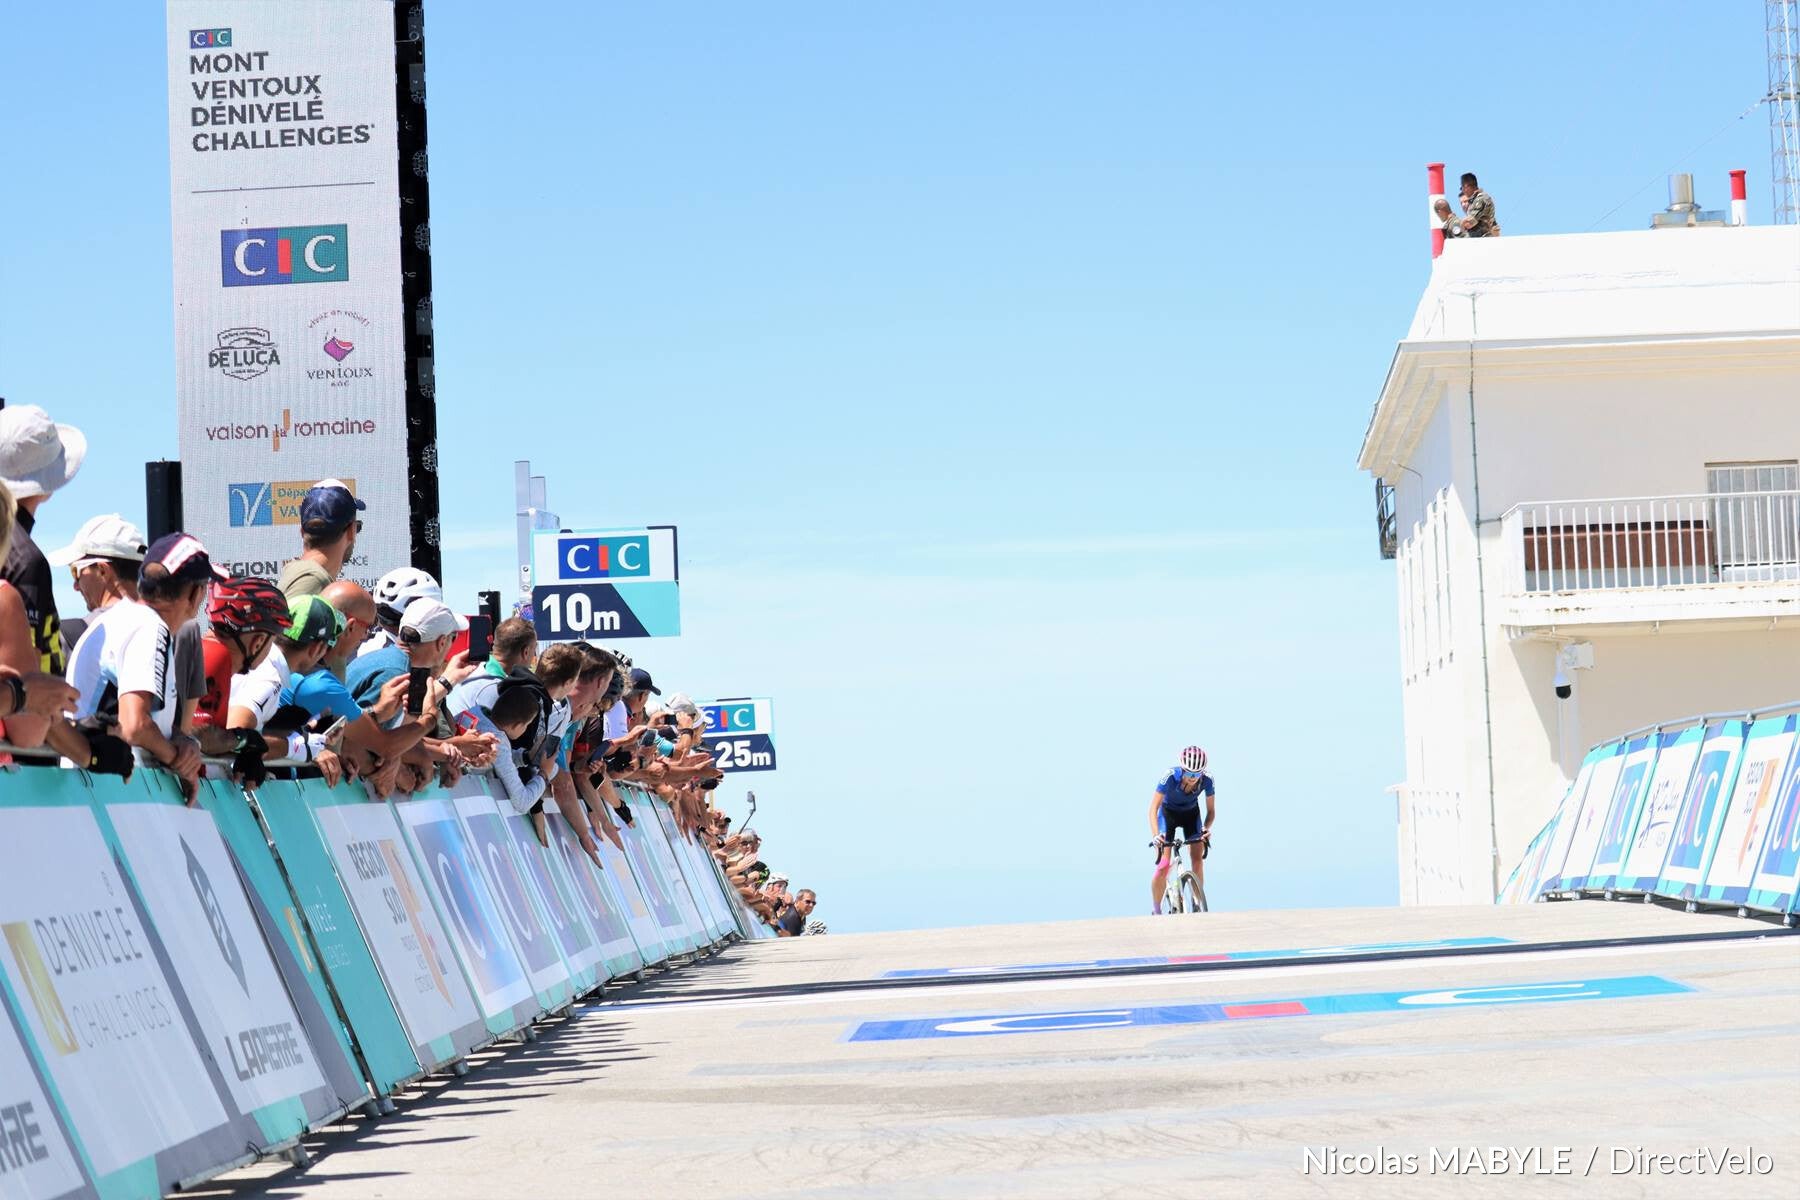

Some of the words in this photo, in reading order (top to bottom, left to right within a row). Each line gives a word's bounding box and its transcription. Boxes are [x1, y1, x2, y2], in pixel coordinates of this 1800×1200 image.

[190, 51, 269, 74] MONT
[191, 75, 322, 101] VENTOUX
[191, 96, 324, 127] DÉNIVELÉ
[231, 232, 339, 279] CIC
[208, 351, 230, 369] DE
[234, 349, 280, 367] LUCA
[206, 423, 269, 441] vaison
[294, 417, 376, 437] romaine
[565, 541, 643, 574] CIC
[542, 593, 620, 632] 10m
[715, 740, 771, 768] 25m
[224, 1022, 304, 1081] LAPIERRE
